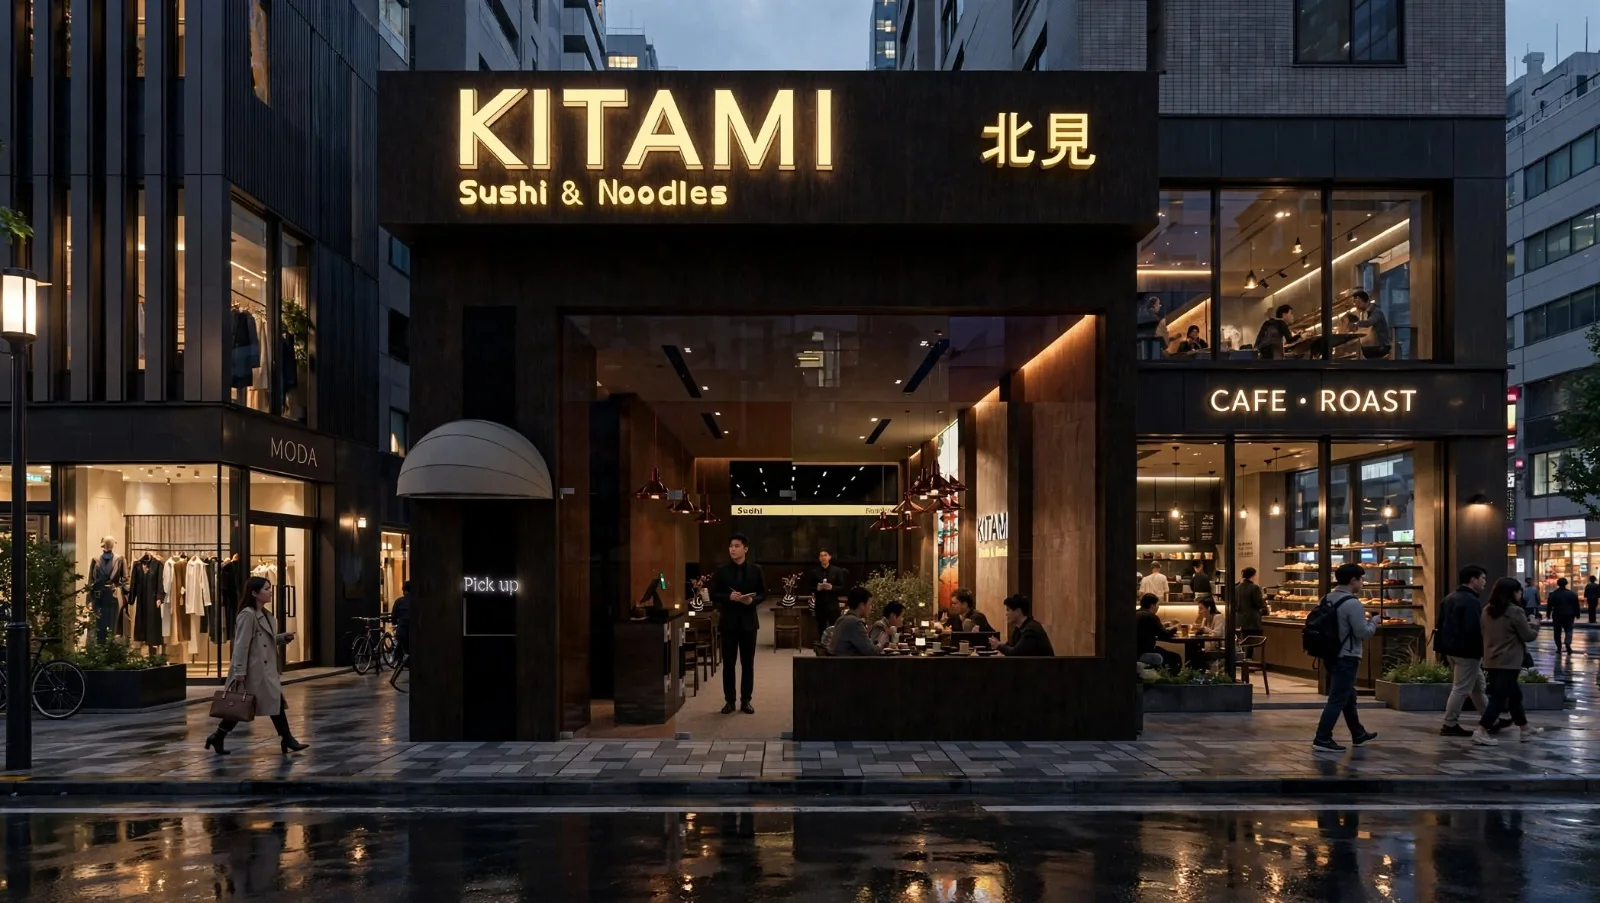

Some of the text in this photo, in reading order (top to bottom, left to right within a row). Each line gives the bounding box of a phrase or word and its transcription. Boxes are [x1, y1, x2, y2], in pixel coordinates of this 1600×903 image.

[459, 88, 833, 170] KITAMI
[981, 112, 1097, 169] 北見
[459, 179, 728, 206] Sushi & Noodles
[1210, 389, 1287, 412] CAFE
[1320, 389, 1417, 412] ROAST
[270, 437, 318, 468] MODA
[463, 576, 519, 596] Pick up
